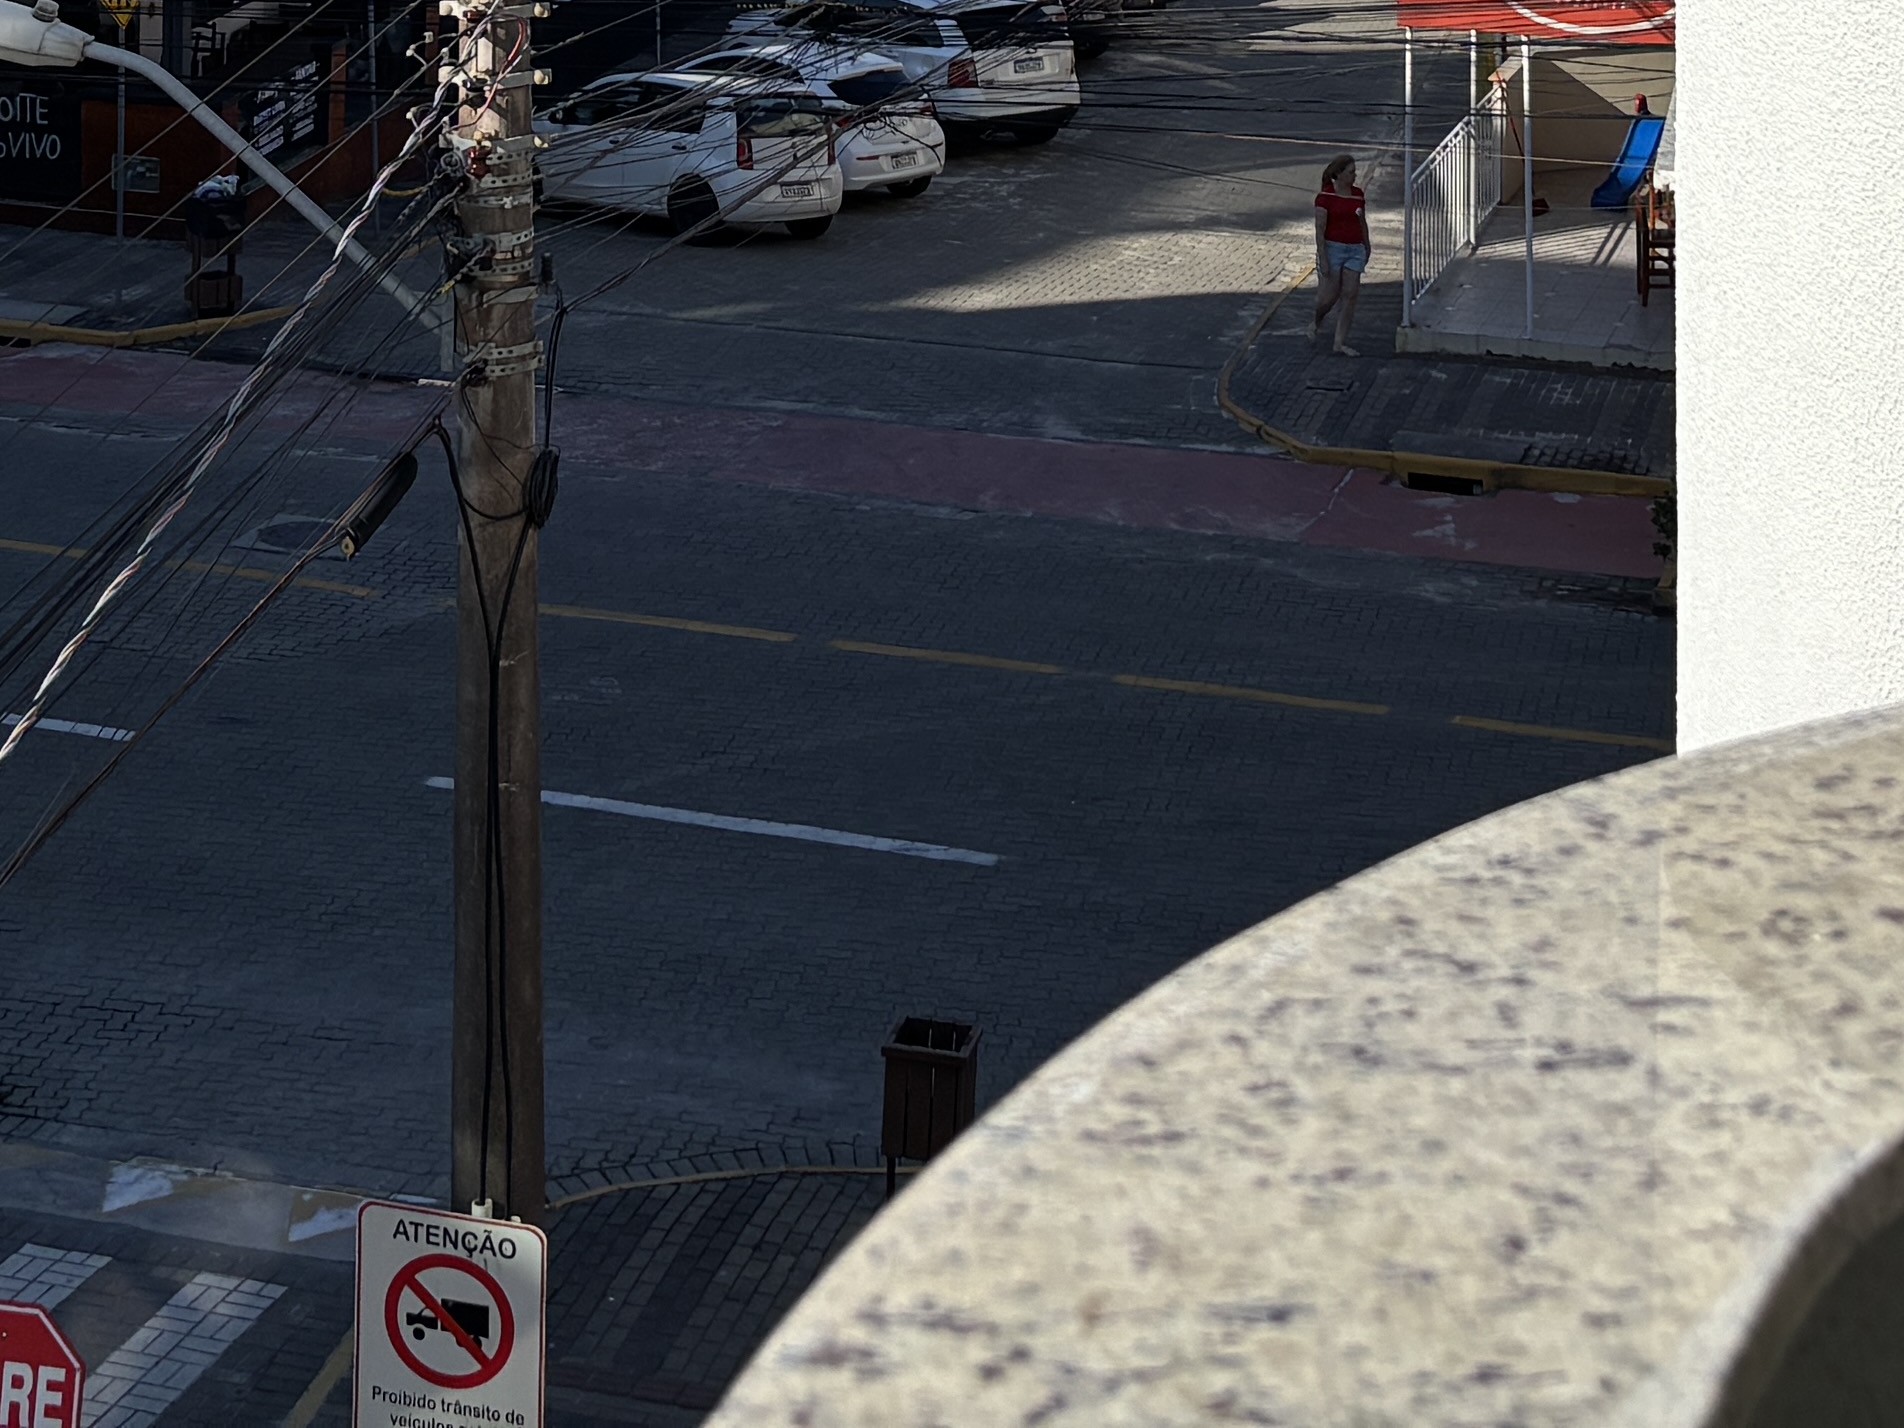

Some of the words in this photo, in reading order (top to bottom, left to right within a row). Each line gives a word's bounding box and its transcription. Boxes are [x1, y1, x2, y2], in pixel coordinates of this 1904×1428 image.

[8, 132, 62, 160] VIVO
[392, 1218, 518, 1260] ATENÇÃO
[371, 1386, 437, 1412] Proibido
[441, 1398, 501, 1423] trânsito
